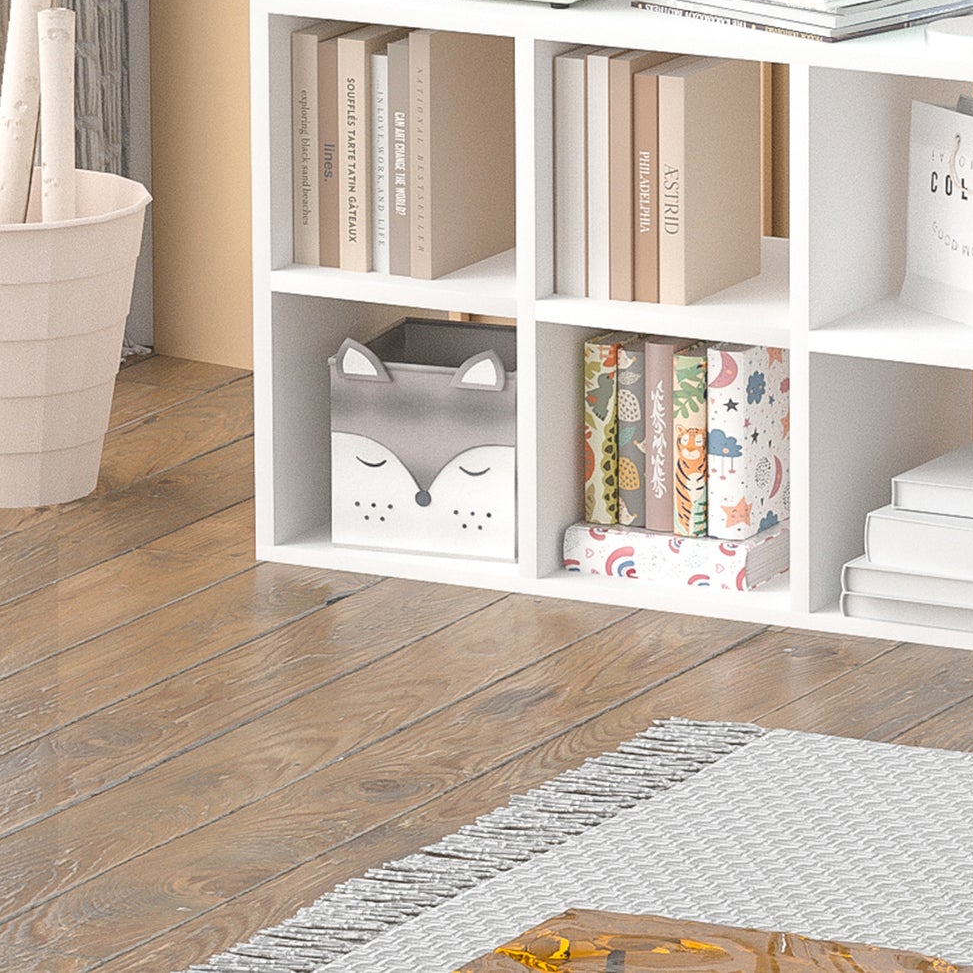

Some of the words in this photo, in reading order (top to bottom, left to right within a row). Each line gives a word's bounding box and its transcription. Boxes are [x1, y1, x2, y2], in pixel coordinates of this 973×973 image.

[299, 90, 310, 135] exploring
[347, 78, 358, 126] SOUFFLÉS
[301, 138, 311, 163] black
[324, 143, 335, 182] lines.
[348, 130, 356, 161] TARTE
[302, 165, 311, 186] sand
[348, 163, 357, 193] TATIN
[639, 151, 650, 233] PHILADELPHIA
[302, 188, 312, 225] beaches
[664, 163, 679, 235] ASTRID
